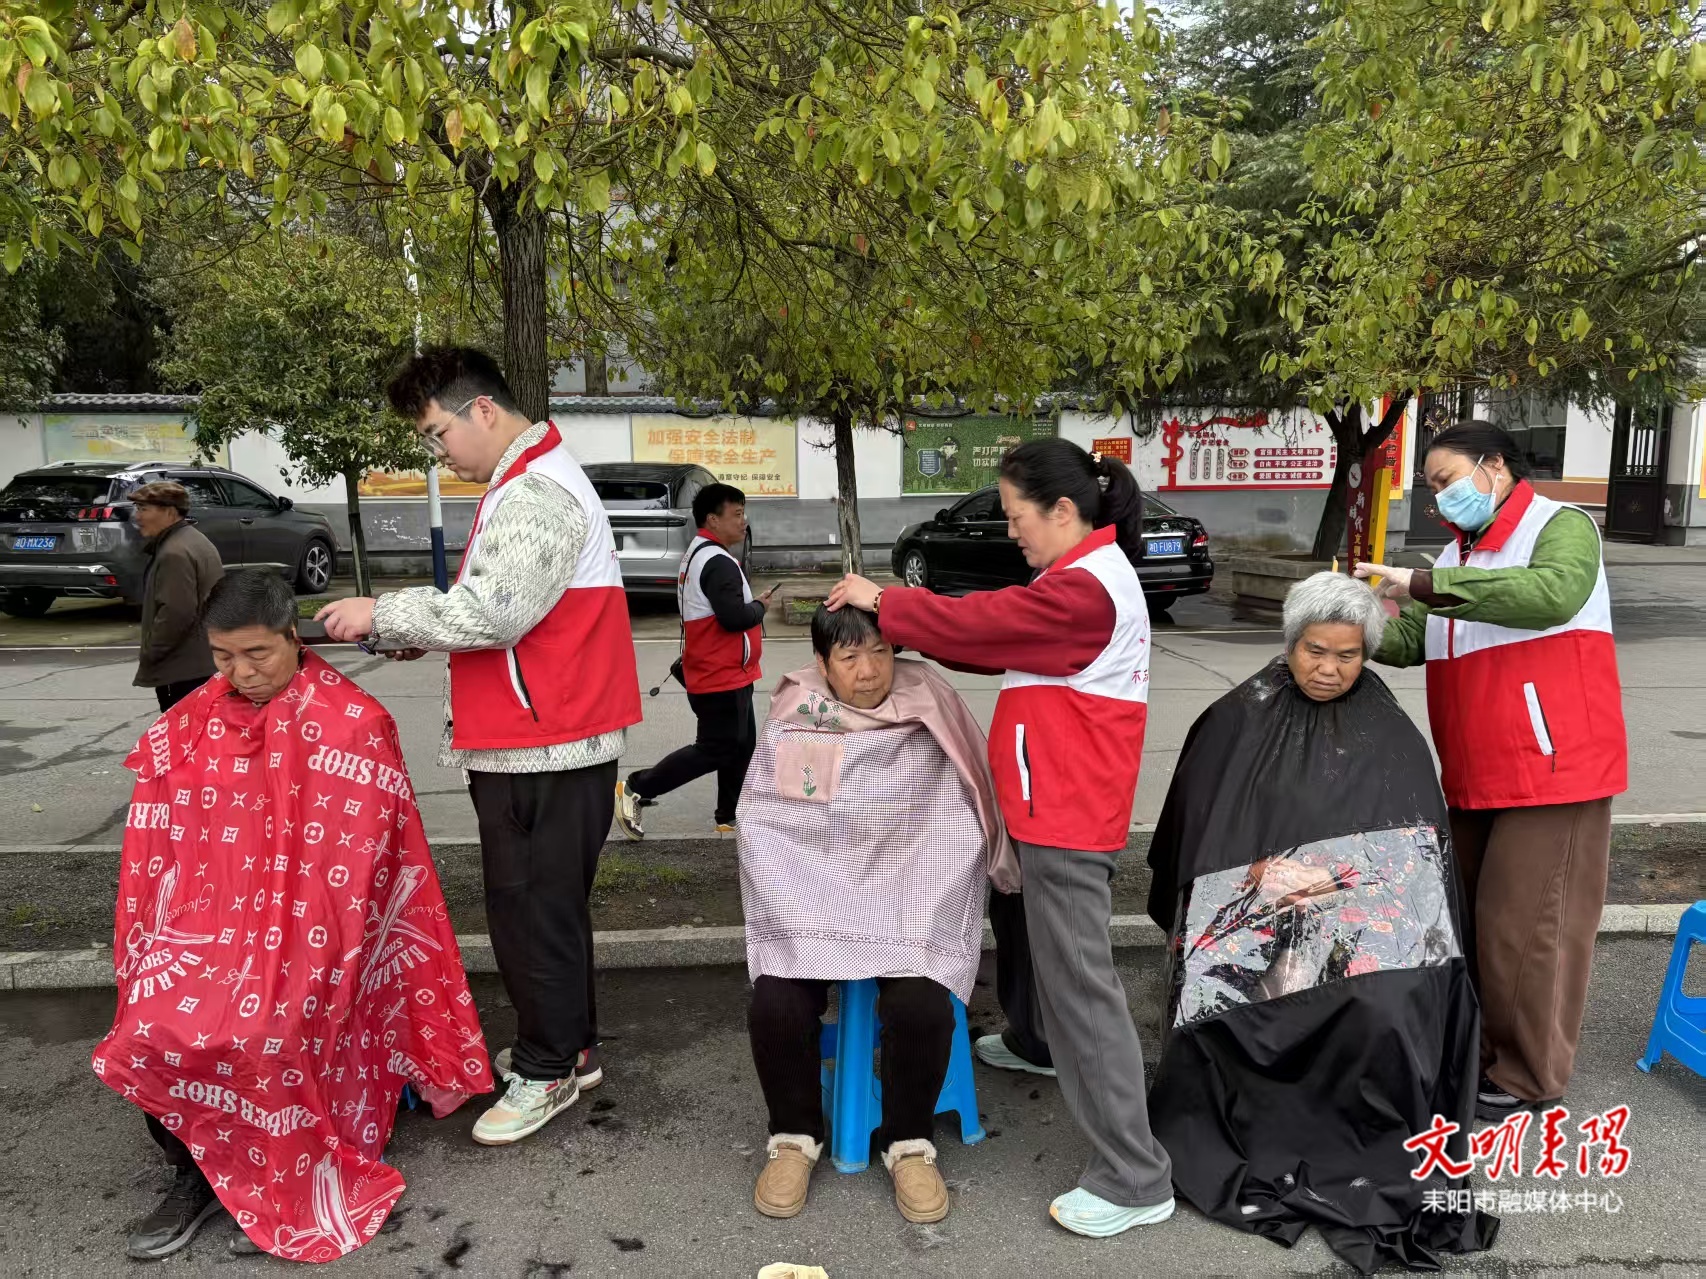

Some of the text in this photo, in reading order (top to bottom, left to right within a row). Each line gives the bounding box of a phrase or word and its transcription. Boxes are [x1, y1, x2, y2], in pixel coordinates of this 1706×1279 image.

[648, 429, 757, 445] 加强安全法制
[669, 448, 777, 465] 保障安全生产
[307, 744, 376, 785] SHOP
[128, 950, 203, 1005] BARBE
[367, 944, 430, 995] BARBER
[168, 1078, 322, 1137] BARBER SHOP
